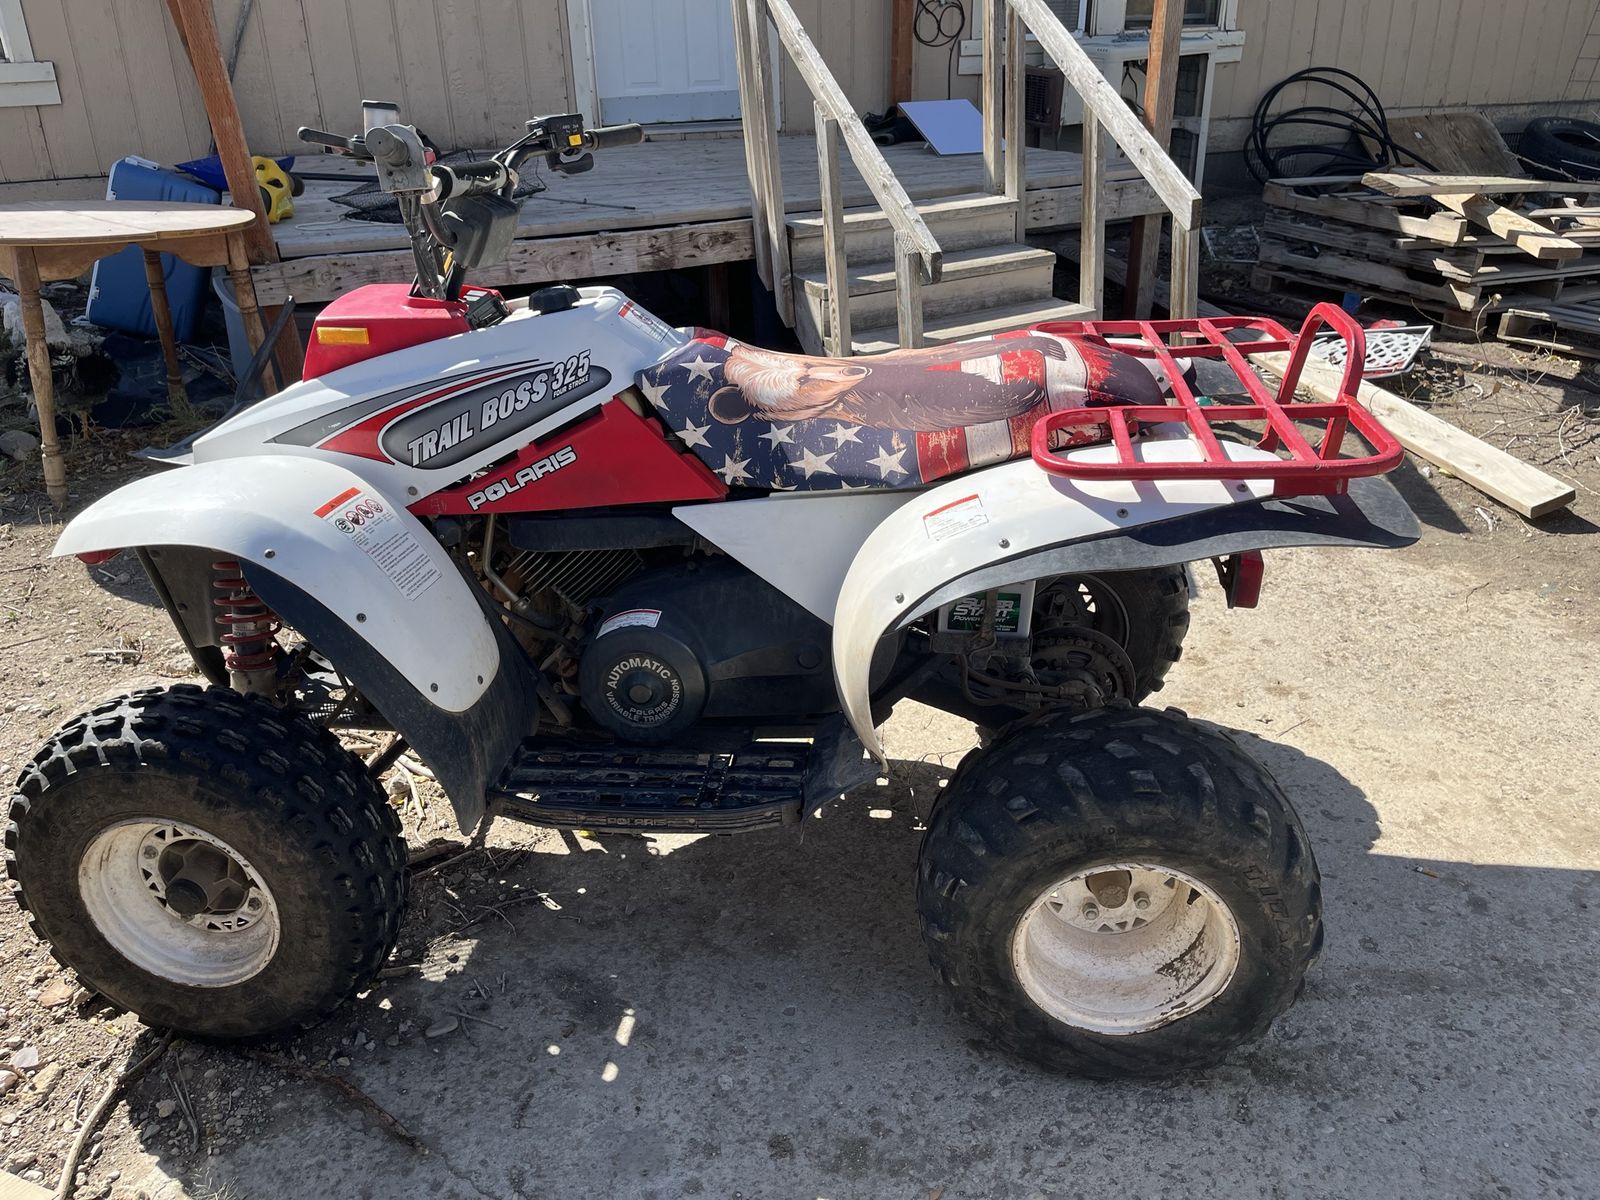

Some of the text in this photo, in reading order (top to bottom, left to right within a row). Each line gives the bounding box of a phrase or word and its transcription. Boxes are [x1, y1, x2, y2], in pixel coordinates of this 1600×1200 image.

[553, 374, 589, 398] FOUR STROKE
[408, 349, 591, 468] TRAIL BOSS 325
[467, 445, 577, 511] POLARIS
[961, 597, 1014, 608] SUER
[607, 657, 671, 689] AUTOMATIC
[606, 679, 680, 723] VARIABLE TRANSMISSION
[630, 701, 668, 716] POLARIS
